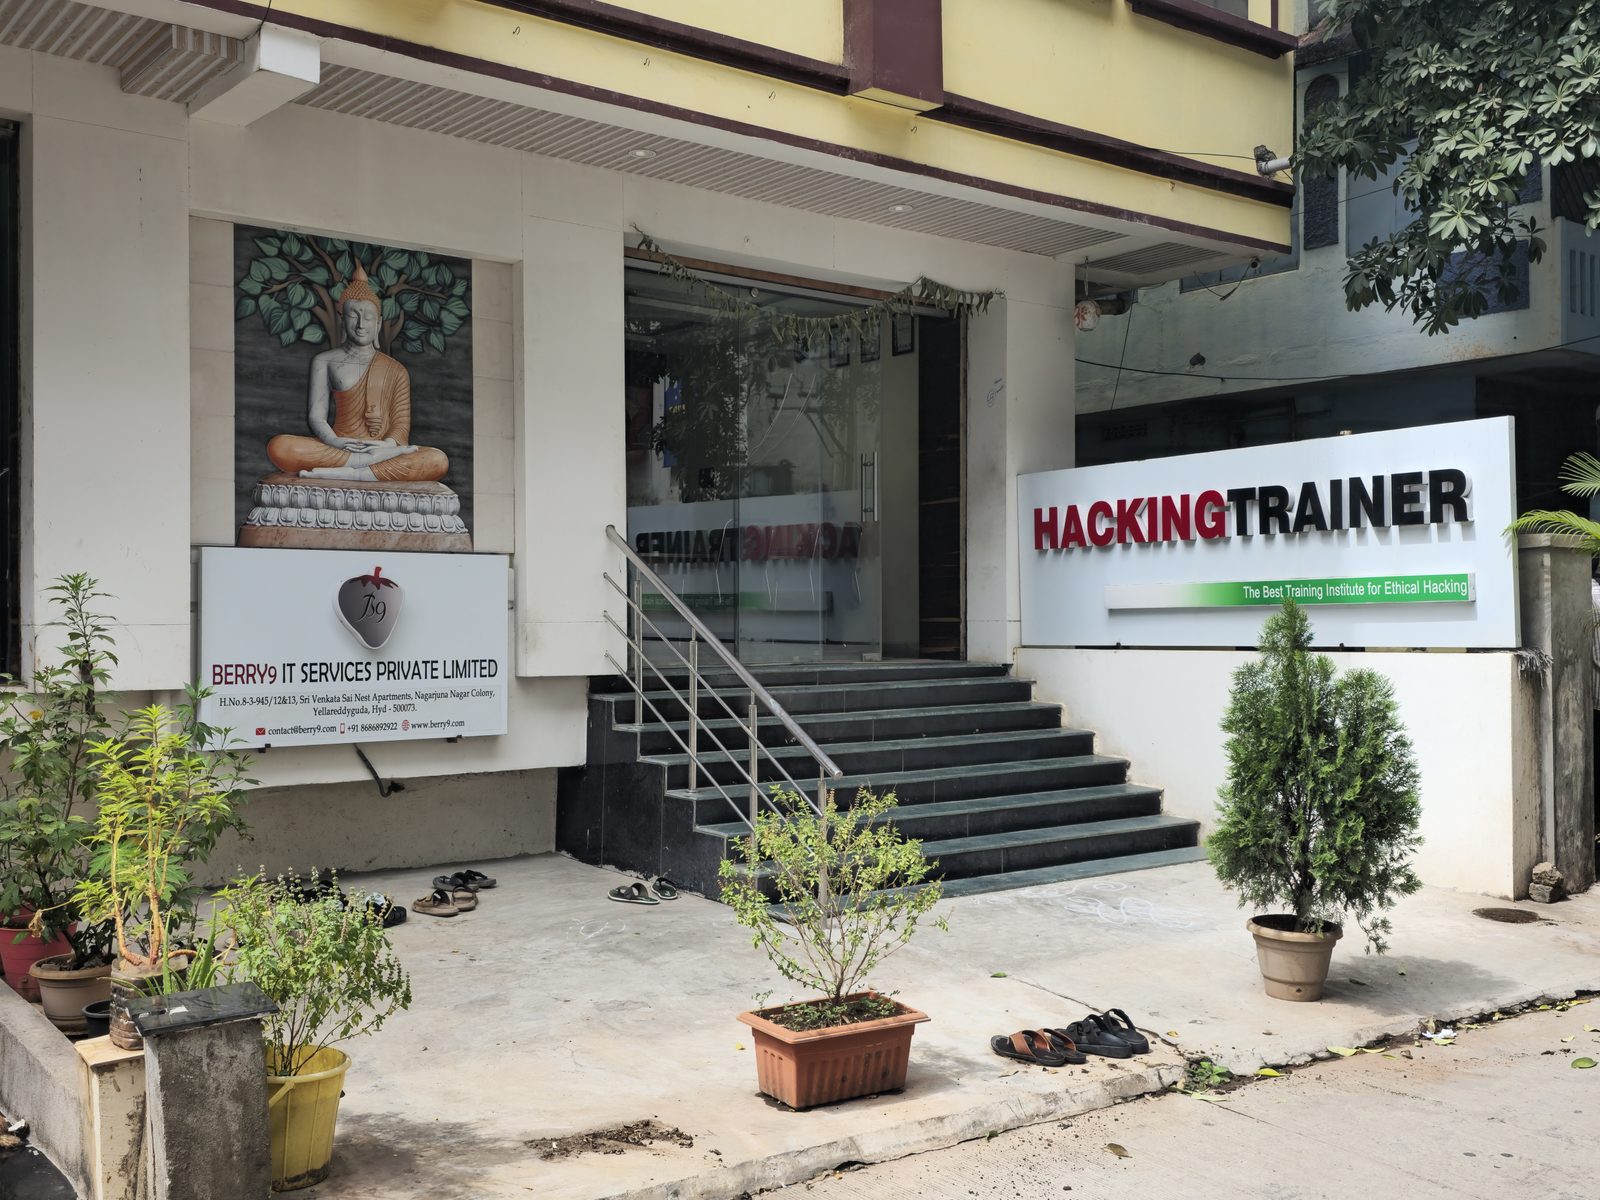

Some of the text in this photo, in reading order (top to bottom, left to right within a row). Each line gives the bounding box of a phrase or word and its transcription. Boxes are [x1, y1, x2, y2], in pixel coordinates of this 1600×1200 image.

[1033, 468, 1470, 551] HACKINGTRAINER
[1243, 579, 1467, 600] The Best Training Institute for Ethical Hacking
[212, 659, 498, 686] BERRY9 IT SERVICES PRIVATE LIMITED
[300, 695, 310, 704] Sri
[312, 694, 341, 704] Venkata
[342, 693, 353, 703] Sai
[354, 693, 371, 702] Nest
[372, 690, 413, 703] Apartments,
[414, 690, 449, 702] Nagarjuna
[450, 689, 470, 701] Nagar
[471, 688, 496, 698] Colony,
[313, 706, 370, 717] Yellareddyguda,
[372, 704, 387, 716] Hyd
[393, 703, 418, 713] 500073.
[268, 724, 337, 736] contact@berry9.com
[347, 723, 359, 733] +91
[411, 720, 465, 730] www.berry9.com
